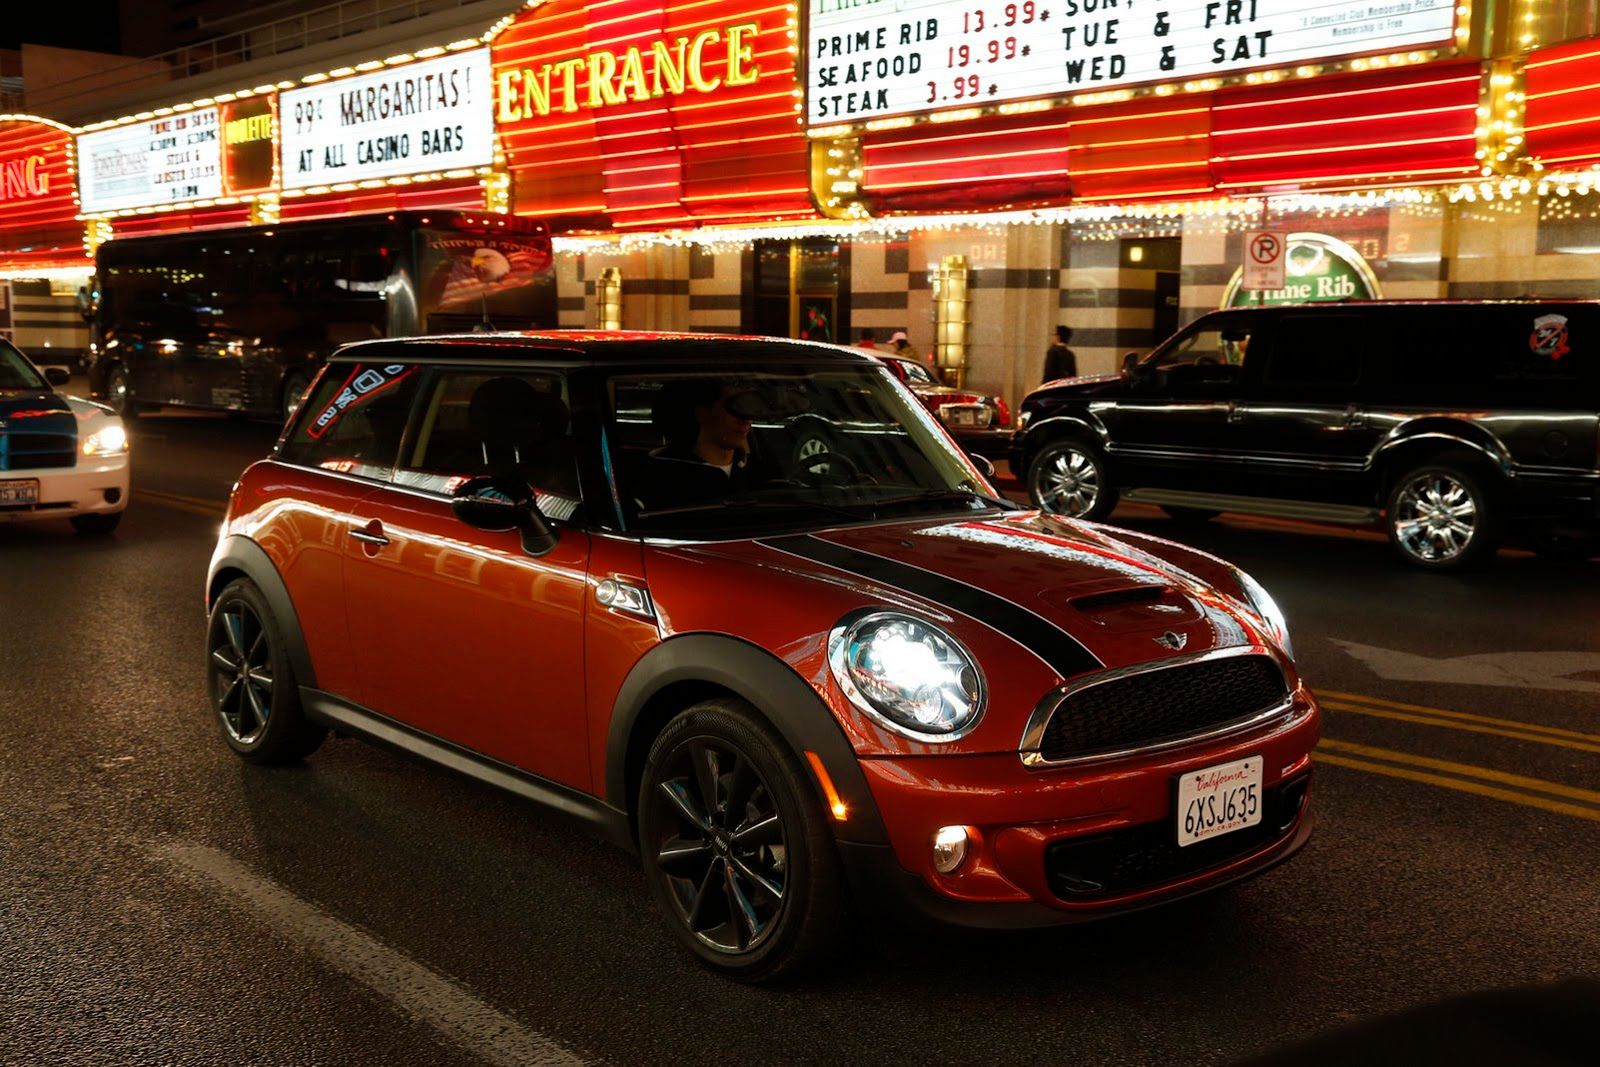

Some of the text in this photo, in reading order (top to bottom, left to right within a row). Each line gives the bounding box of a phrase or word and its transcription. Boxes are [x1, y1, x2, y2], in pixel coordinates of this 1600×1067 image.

[817, 27, 887, 59] PRIME
[899, 18, 938, 45] RIB
[818, 53, 922, 88] SEAFOOD
[1062, 19, 1119, 50] TUE
[1154, 11, 1170, 37] &
[1204, 0, 1257, 29] FRI
[496, 21, 760, 124] ENTRANCE
[818, 88, 889, 117] STEAK
[1065, 54, 1126, 84] WED
[1159, 45, 1176, 71] &
[1211, 30, 1273, 64] SAT
[298, 125, 464, 173] AT ALL CASINO BARS
[1316, 274, 1356, 298] Rib
[1196, 770, 1249, 792] California
[1185, 782, 1257, 834] 6XSJ635
